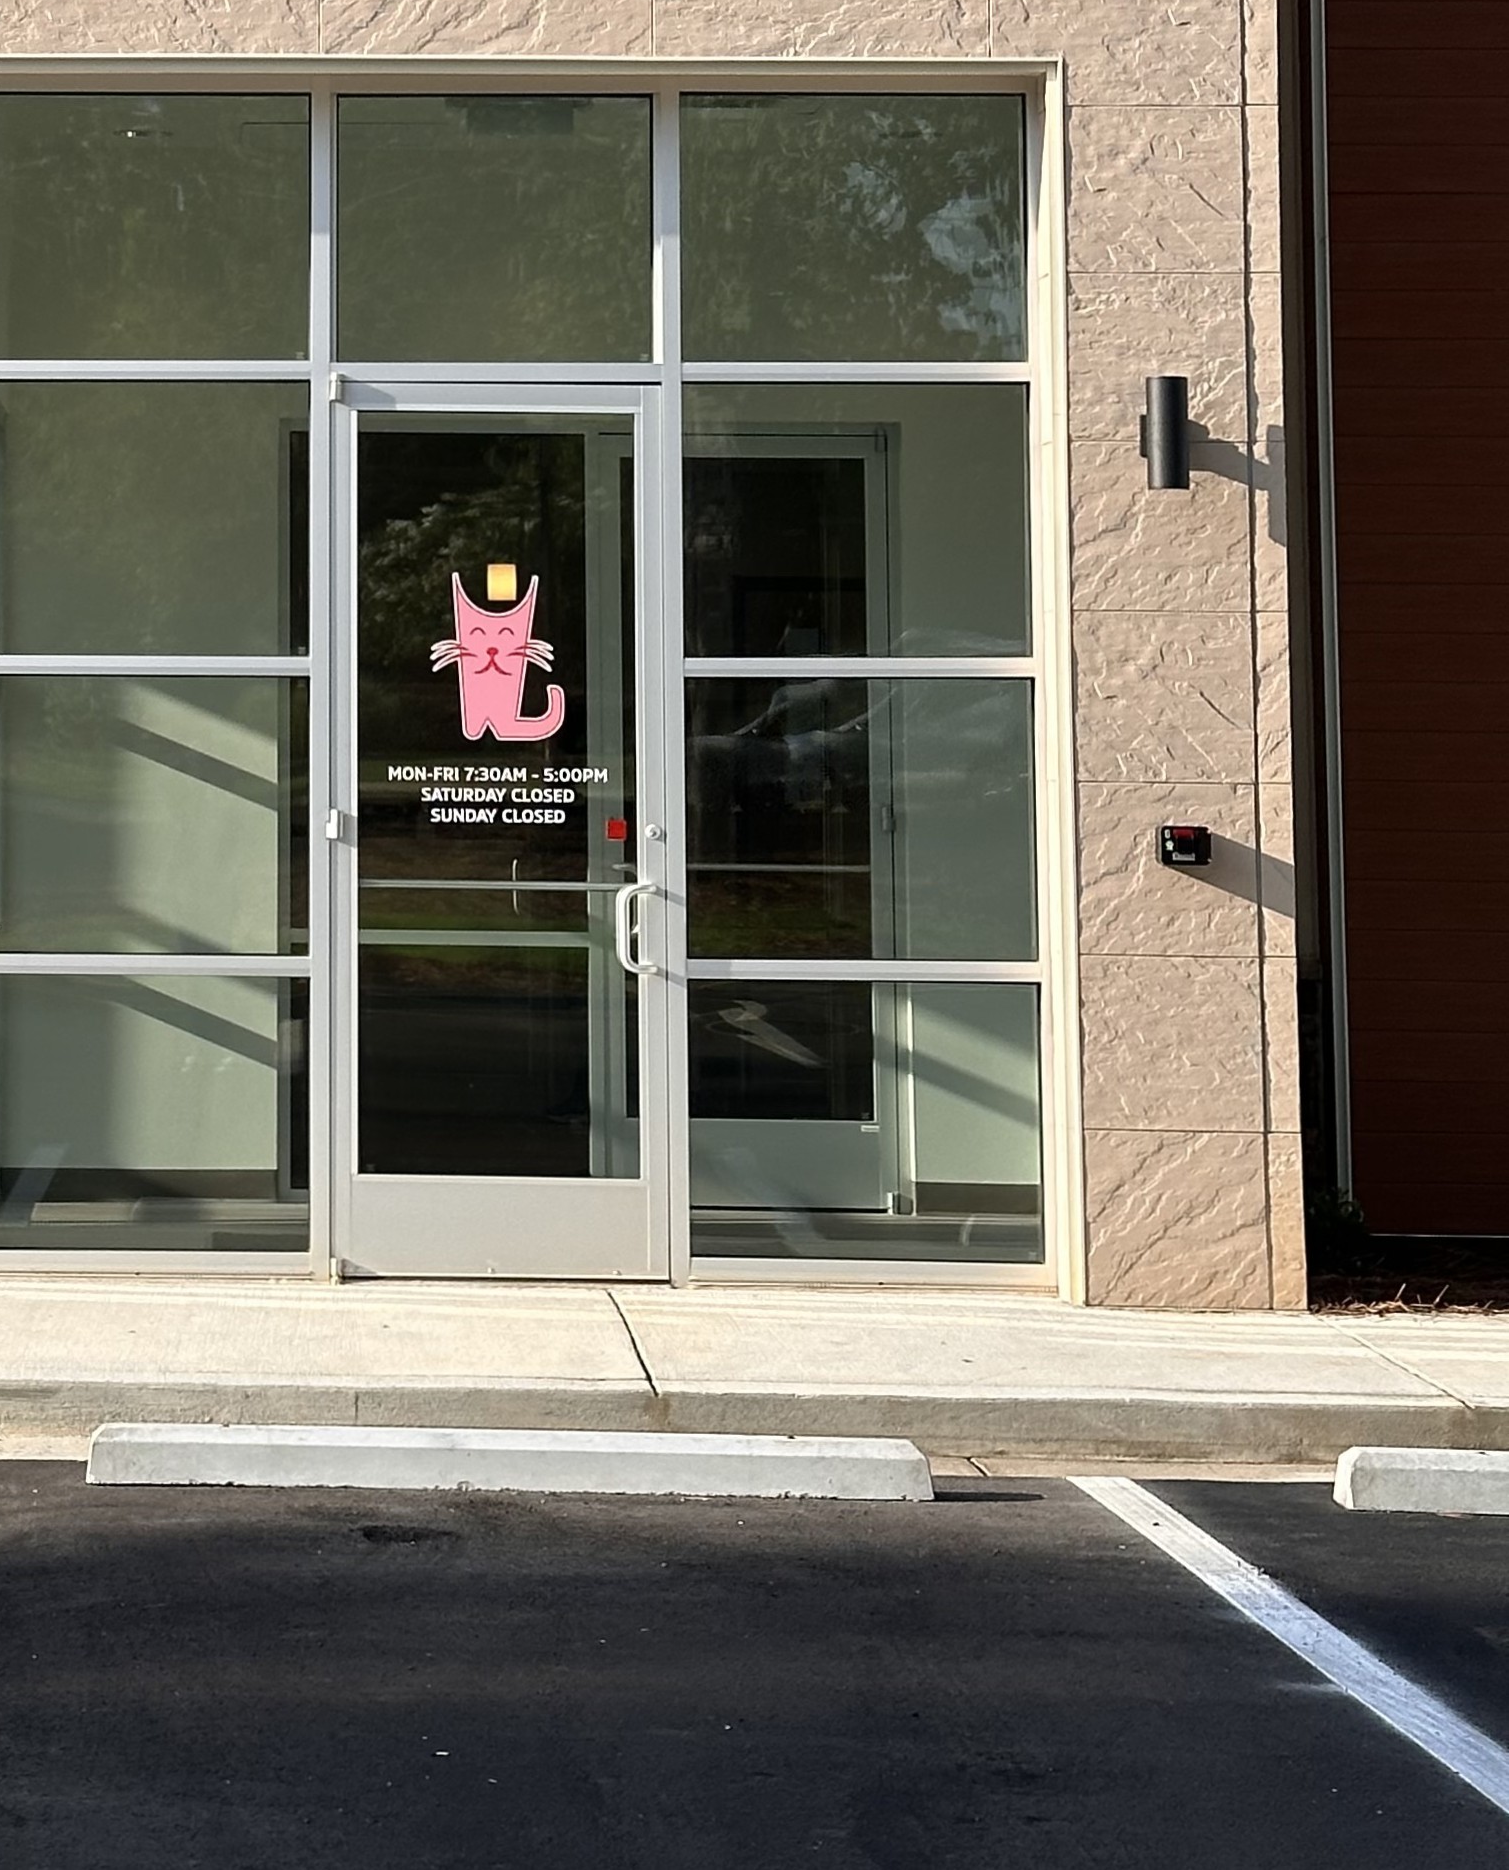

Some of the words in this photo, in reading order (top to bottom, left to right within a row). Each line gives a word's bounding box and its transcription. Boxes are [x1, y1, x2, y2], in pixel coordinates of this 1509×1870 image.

[388, 766, 459, 781] MON-FRI
[464, 767, 527, 782] 7:30AM
[543, 768, 608, 783] 5:00PM
[421, 787, 505, 802] SATURDAY
[511, 788, 575, 803] CLOSED
[430, 808, 497, 823] SUNDAY
[502, 809, 566, 824] CLOSED
